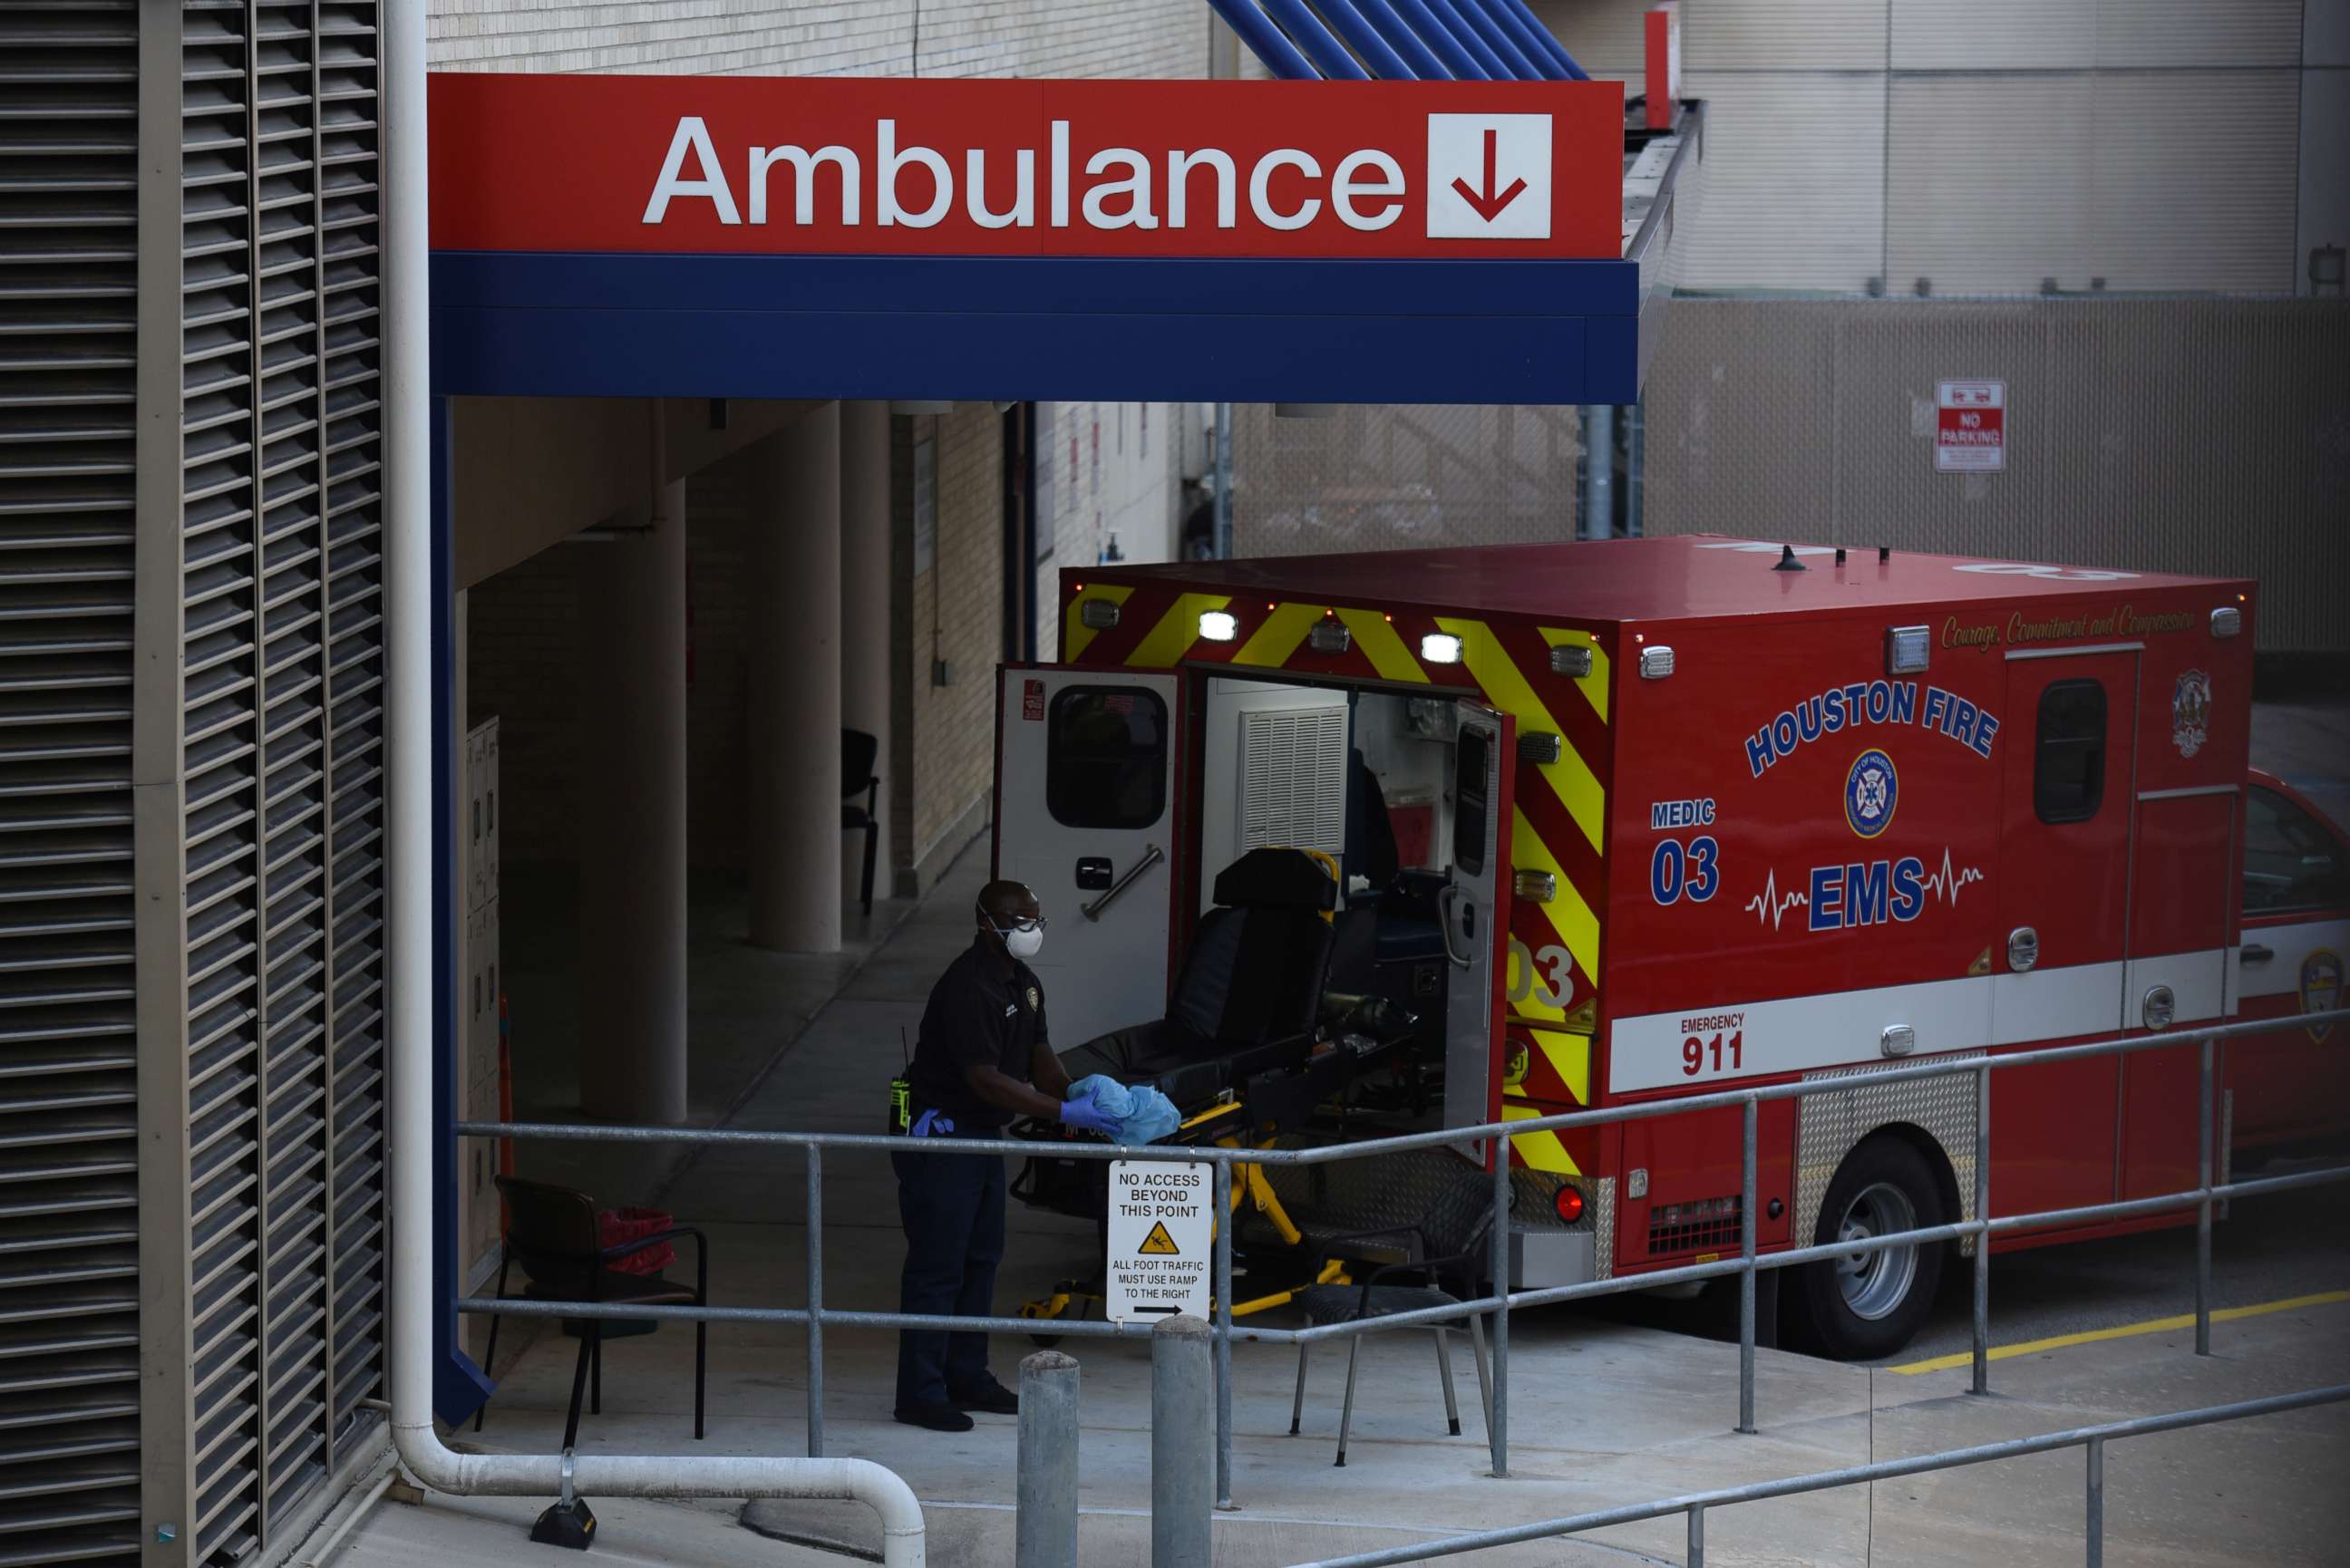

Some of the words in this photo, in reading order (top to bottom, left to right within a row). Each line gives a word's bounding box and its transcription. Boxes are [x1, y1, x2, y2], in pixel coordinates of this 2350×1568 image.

[641, 116, 1406, 231] Ambulance
[1960, 411, 1980, 428] NO
[1942, 429, 2000, 444] PARKING
[2090, 607, 2118, 636] and
[1744, 680, 1917, 779] HOUSTON
[1922, 685, 2000, 760] FIRE
[1850, 765, 1862, 783] CITY
[1861, 756, 1869, 768] OF
[1869, 755, 1893, 780] HOUSTON
[1651, 798, 1716, 829] MEDIC
[1651, 836, 1720, 905] 03
[1809, 856, 1924, 932] EMS
[1681, 1012, 1744, 1033] EMERGENCY
[1682, 1031, 1743, 1076] 911
[1119, 1174, 1140, 1186] NO
[1144, 1174, 1200, 1186] ACCESS
[1131, 1189, 1188, 1202] BEYOND
[1119, 1205, 1151, 1217] THIS
[1156, 1205, 1199, 1218] POINT
[1112, 1260, 1131, 1270] ALL
[1133, 1261, 1160, 1271] FOOT
[1162, 1261, 1204, 1271] TRAFFIC
[1118, 1274, 1144, 1283] MUST
[1147, 1274, 1166, 1284] USE
[1169, 1275, 1198, 1285] RAMP
[1125, 1289, 1138, 1298] TO
[1141, 1289, 1159, 1298] THE
[1161, 1289, 1190, 1299] RIGHT
